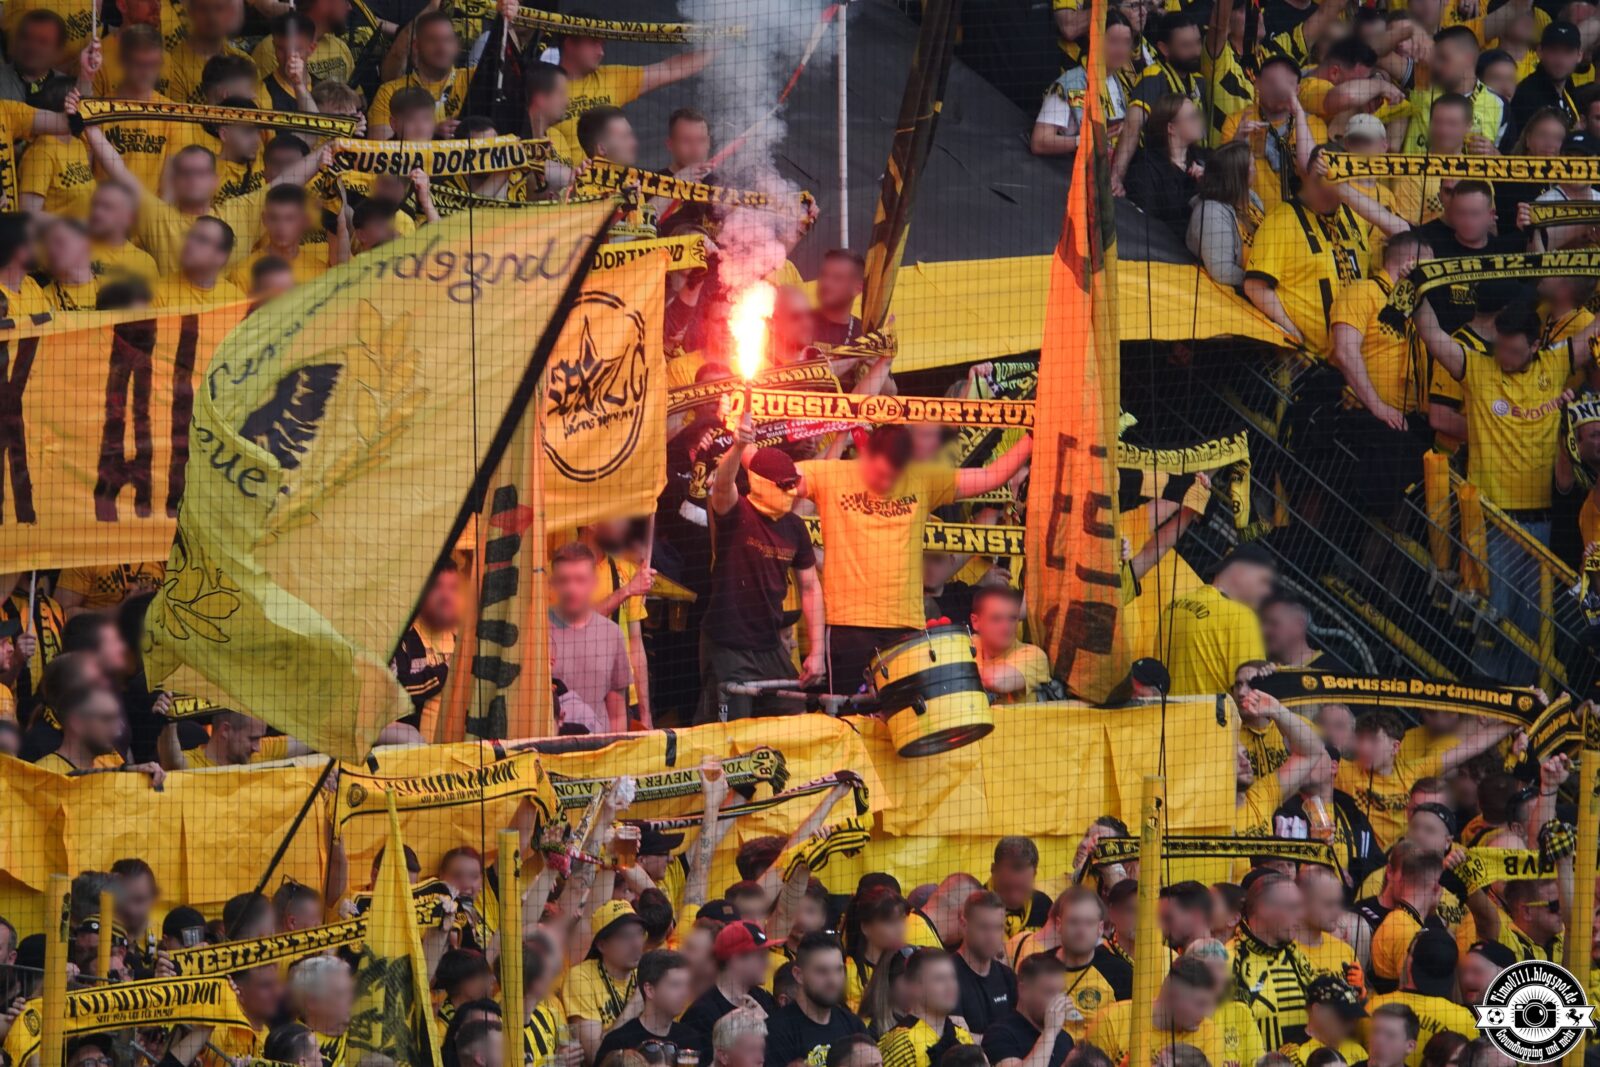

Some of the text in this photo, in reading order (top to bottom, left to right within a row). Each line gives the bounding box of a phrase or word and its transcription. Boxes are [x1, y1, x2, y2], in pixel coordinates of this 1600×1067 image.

[561, 14, 614, 30] NEVER
[620, 21, 667, 33] WALK
[1422, 256, 1483, 279] DER
[1490, 253, 1534, 270] 12.
[729, 390, 1035, 426] ORUSSIA BVB DORTMUN
[1321, 675, 1513, 706] Borussia Dortmund
[640, 771, 693, 791] NEVER
